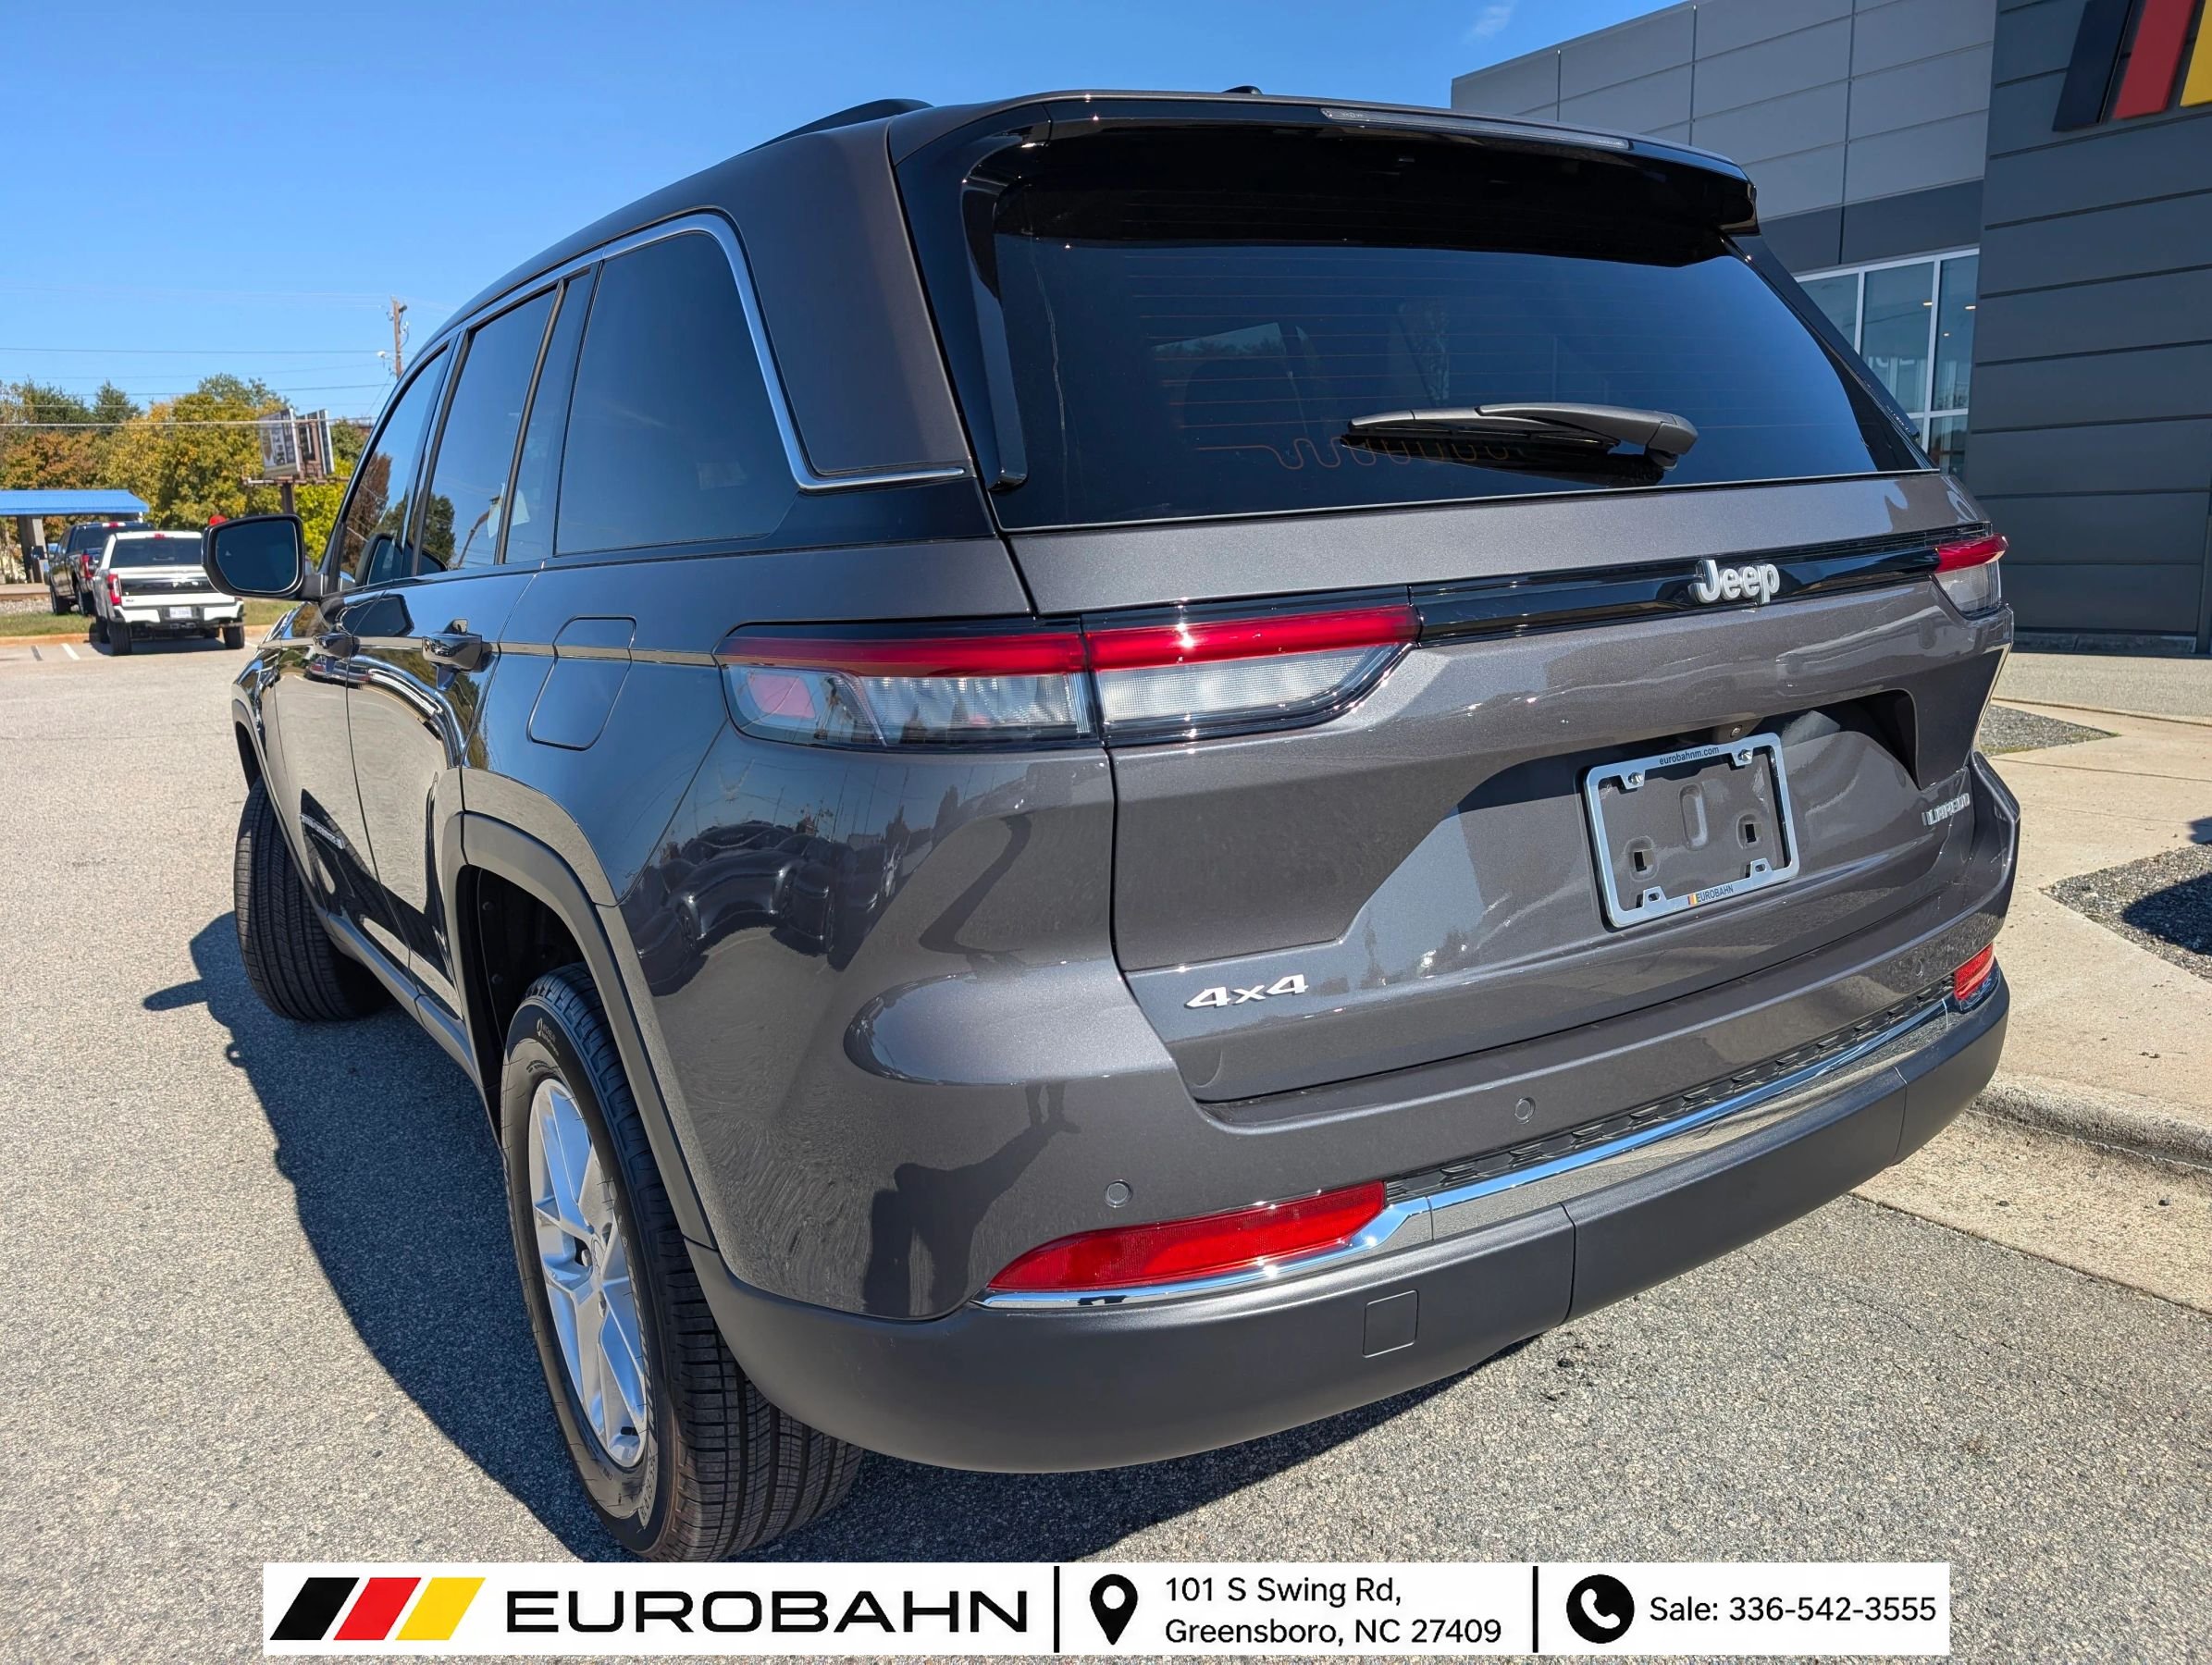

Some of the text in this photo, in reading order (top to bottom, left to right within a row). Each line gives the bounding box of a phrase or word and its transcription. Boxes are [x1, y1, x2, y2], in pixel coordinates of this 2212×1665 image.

[1688, 560, 1780, 605] Jeep
[1659, 746, 1720, 765] eurobahnm.com
[1696, 884, 1734, 902] EUROBAHN
[1184, 974, 1309, 1009] 4x4
